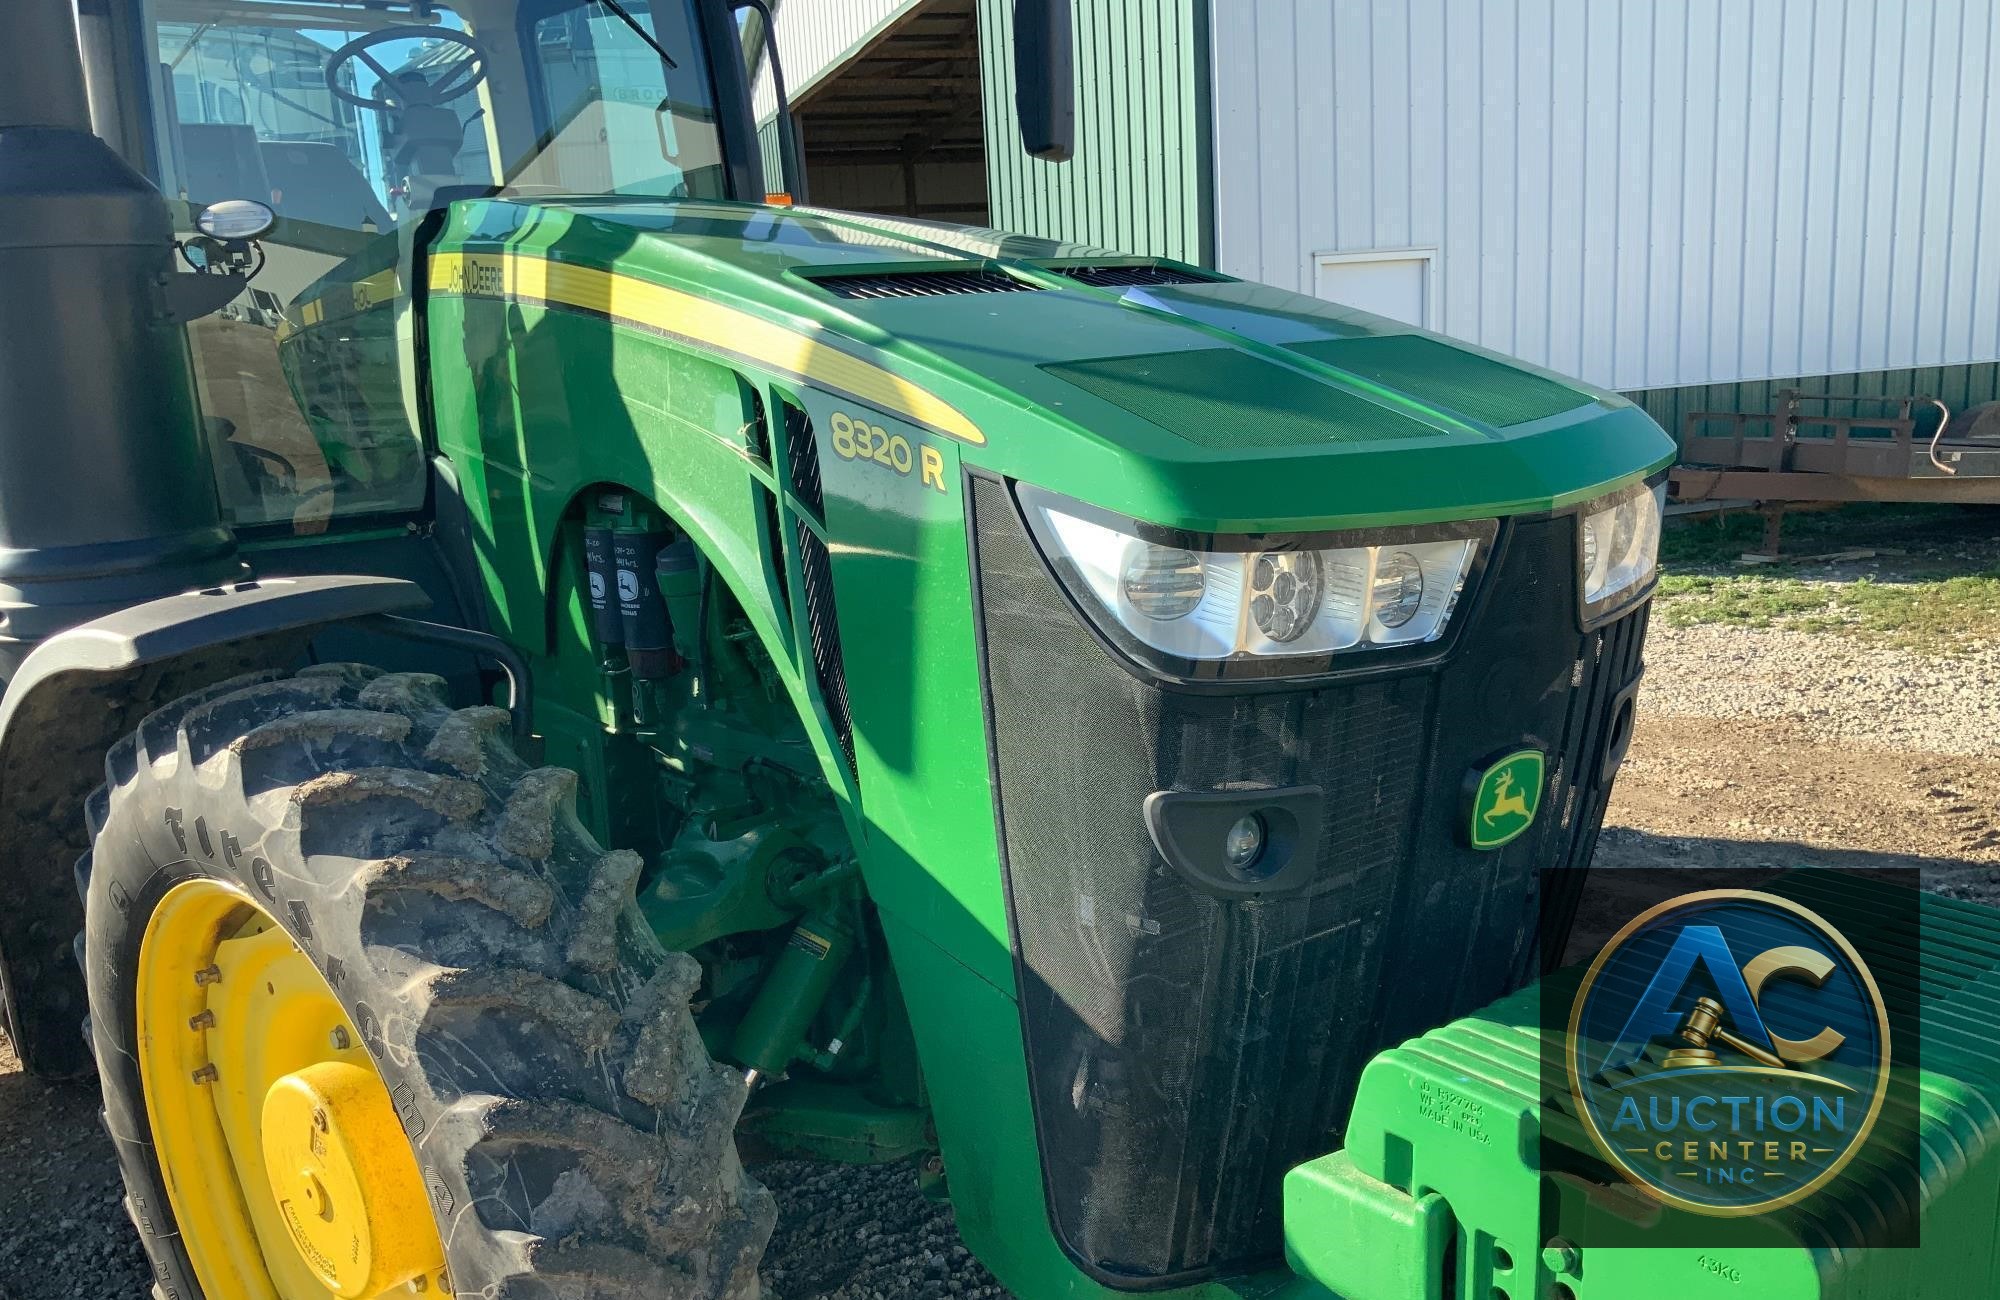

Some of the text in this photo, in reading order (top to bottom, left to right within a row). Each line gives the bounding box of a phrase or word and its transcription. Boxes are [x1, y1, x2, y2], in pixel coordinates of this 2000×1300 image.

[448, 258, 504, 293] JOHN DEERE
[829, 411, 947, 494] 8320 R
[1419, 1105, 1449, 1127] MADE
[1453, 1119, 1464, 1134] IN
[1469, 1126, 1492, 1146] USA
[1697, 1255, 1741, 1282] 43KG
